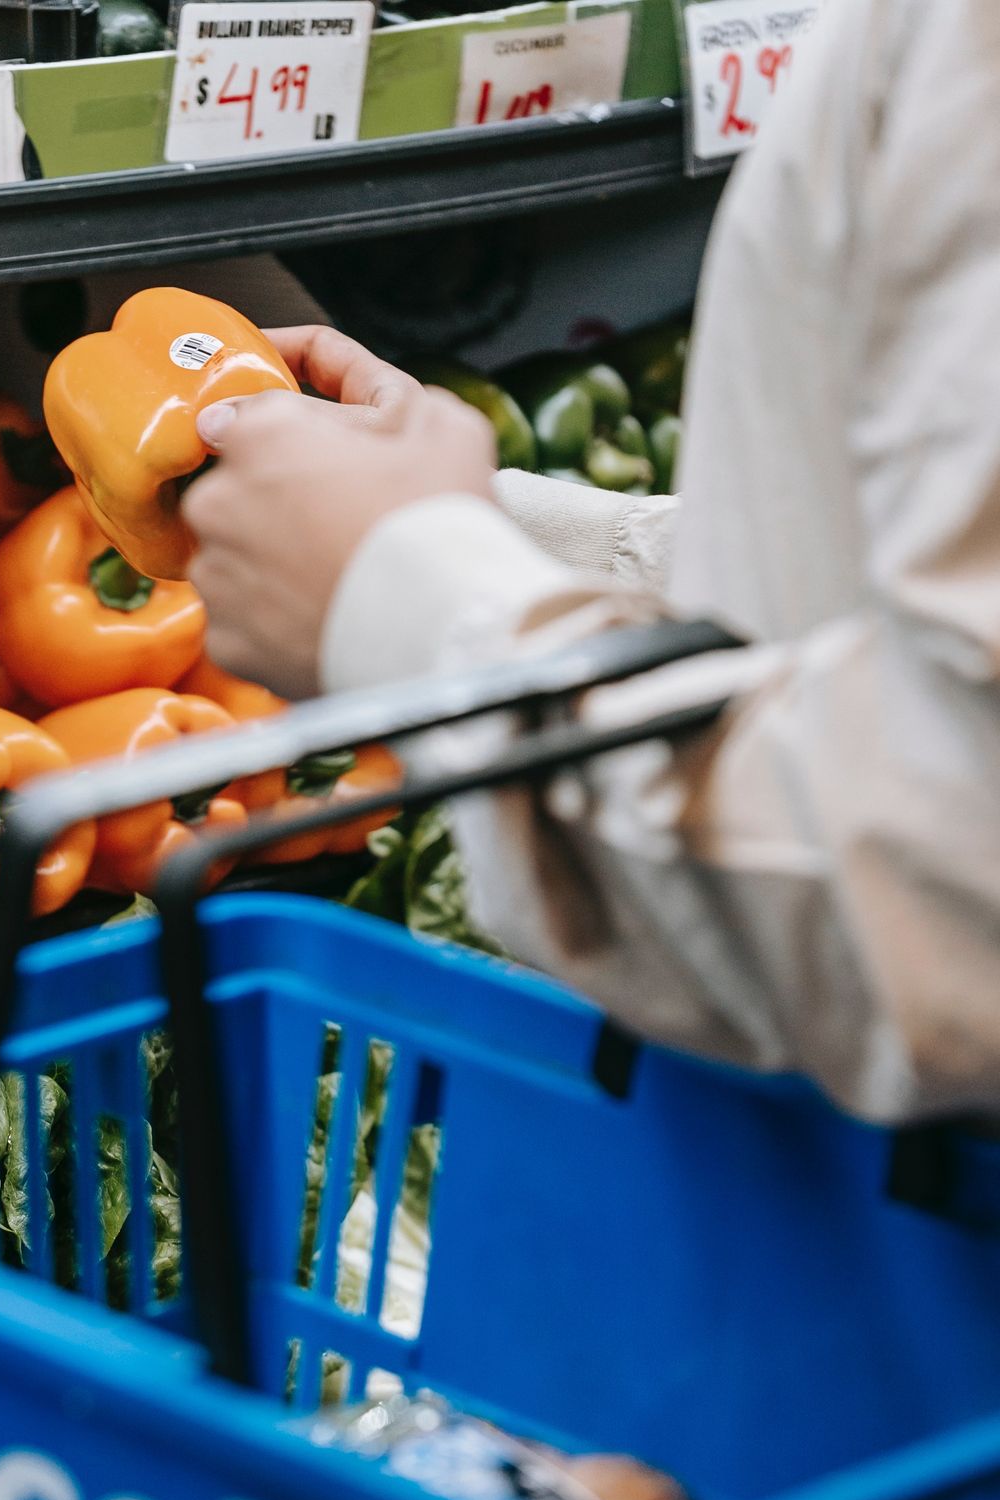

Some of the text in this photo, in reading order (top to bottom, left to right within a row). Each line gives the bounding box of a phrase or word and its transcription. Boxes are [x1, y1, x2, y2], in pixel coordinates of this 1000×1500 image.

[197, 63, 310, 140] $ 4.99
[314, 114, 335, 140] LB
